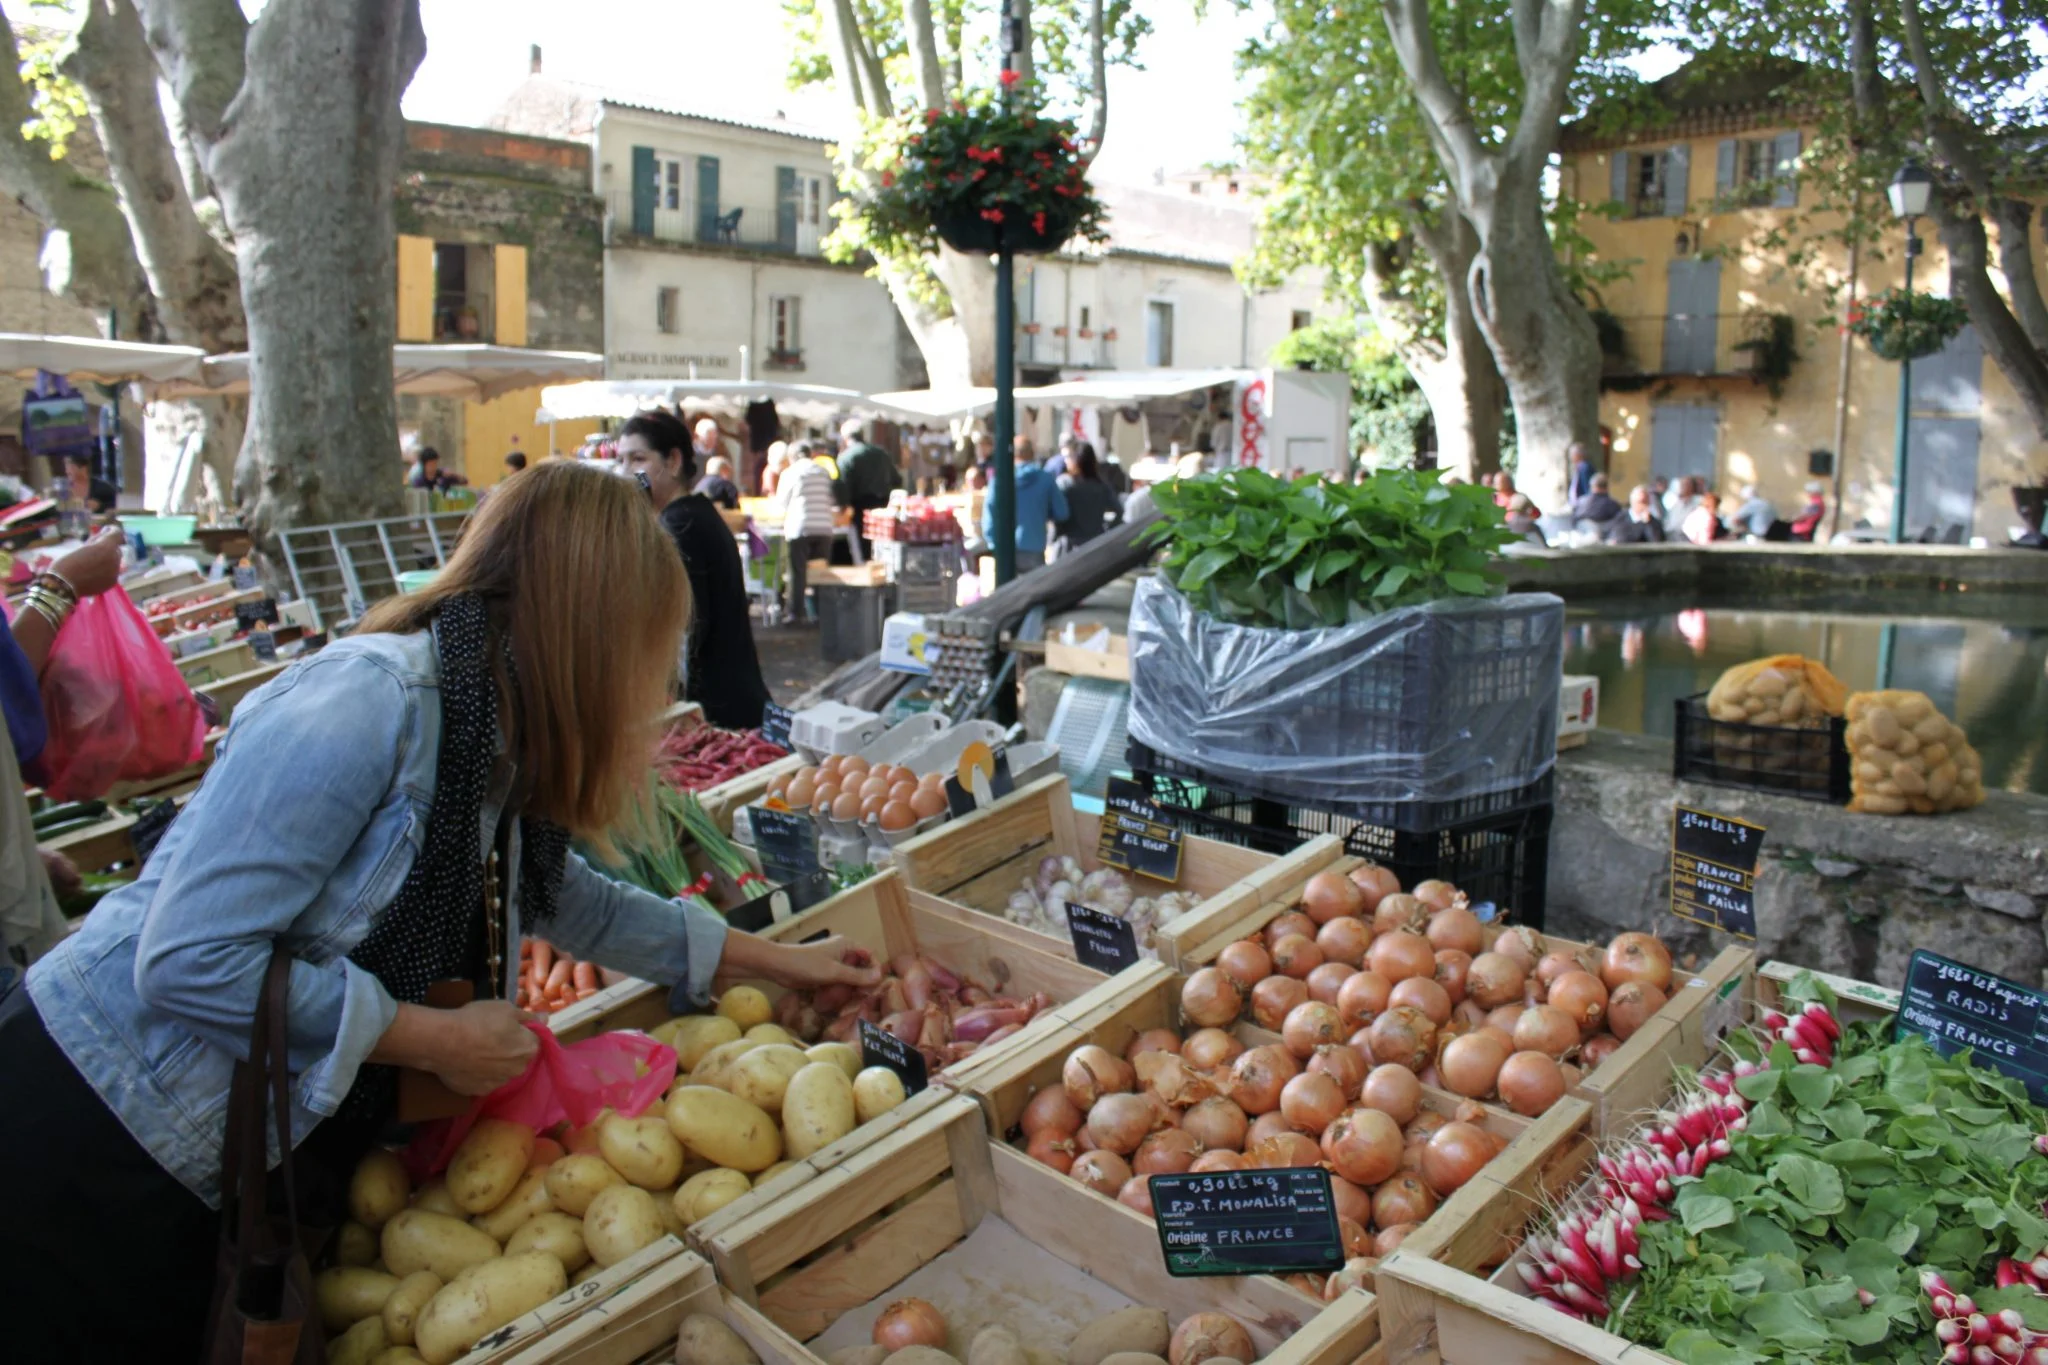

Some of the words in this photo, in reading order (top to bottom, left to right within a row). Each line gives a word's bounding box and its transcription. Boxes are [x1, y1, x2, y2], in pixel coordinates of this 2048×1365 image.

[617, 352, 658, 365] AGENCE
[1697, 861, 1742, 882] FRANCE
[1903, 1007, 1943, 1030] Origine
[1945, 1022, 2016, 1055] FRANCE
[1167, 1230, 1208, 1245] Origine
[1216, 1226, 1295, 1245] FRANCE
